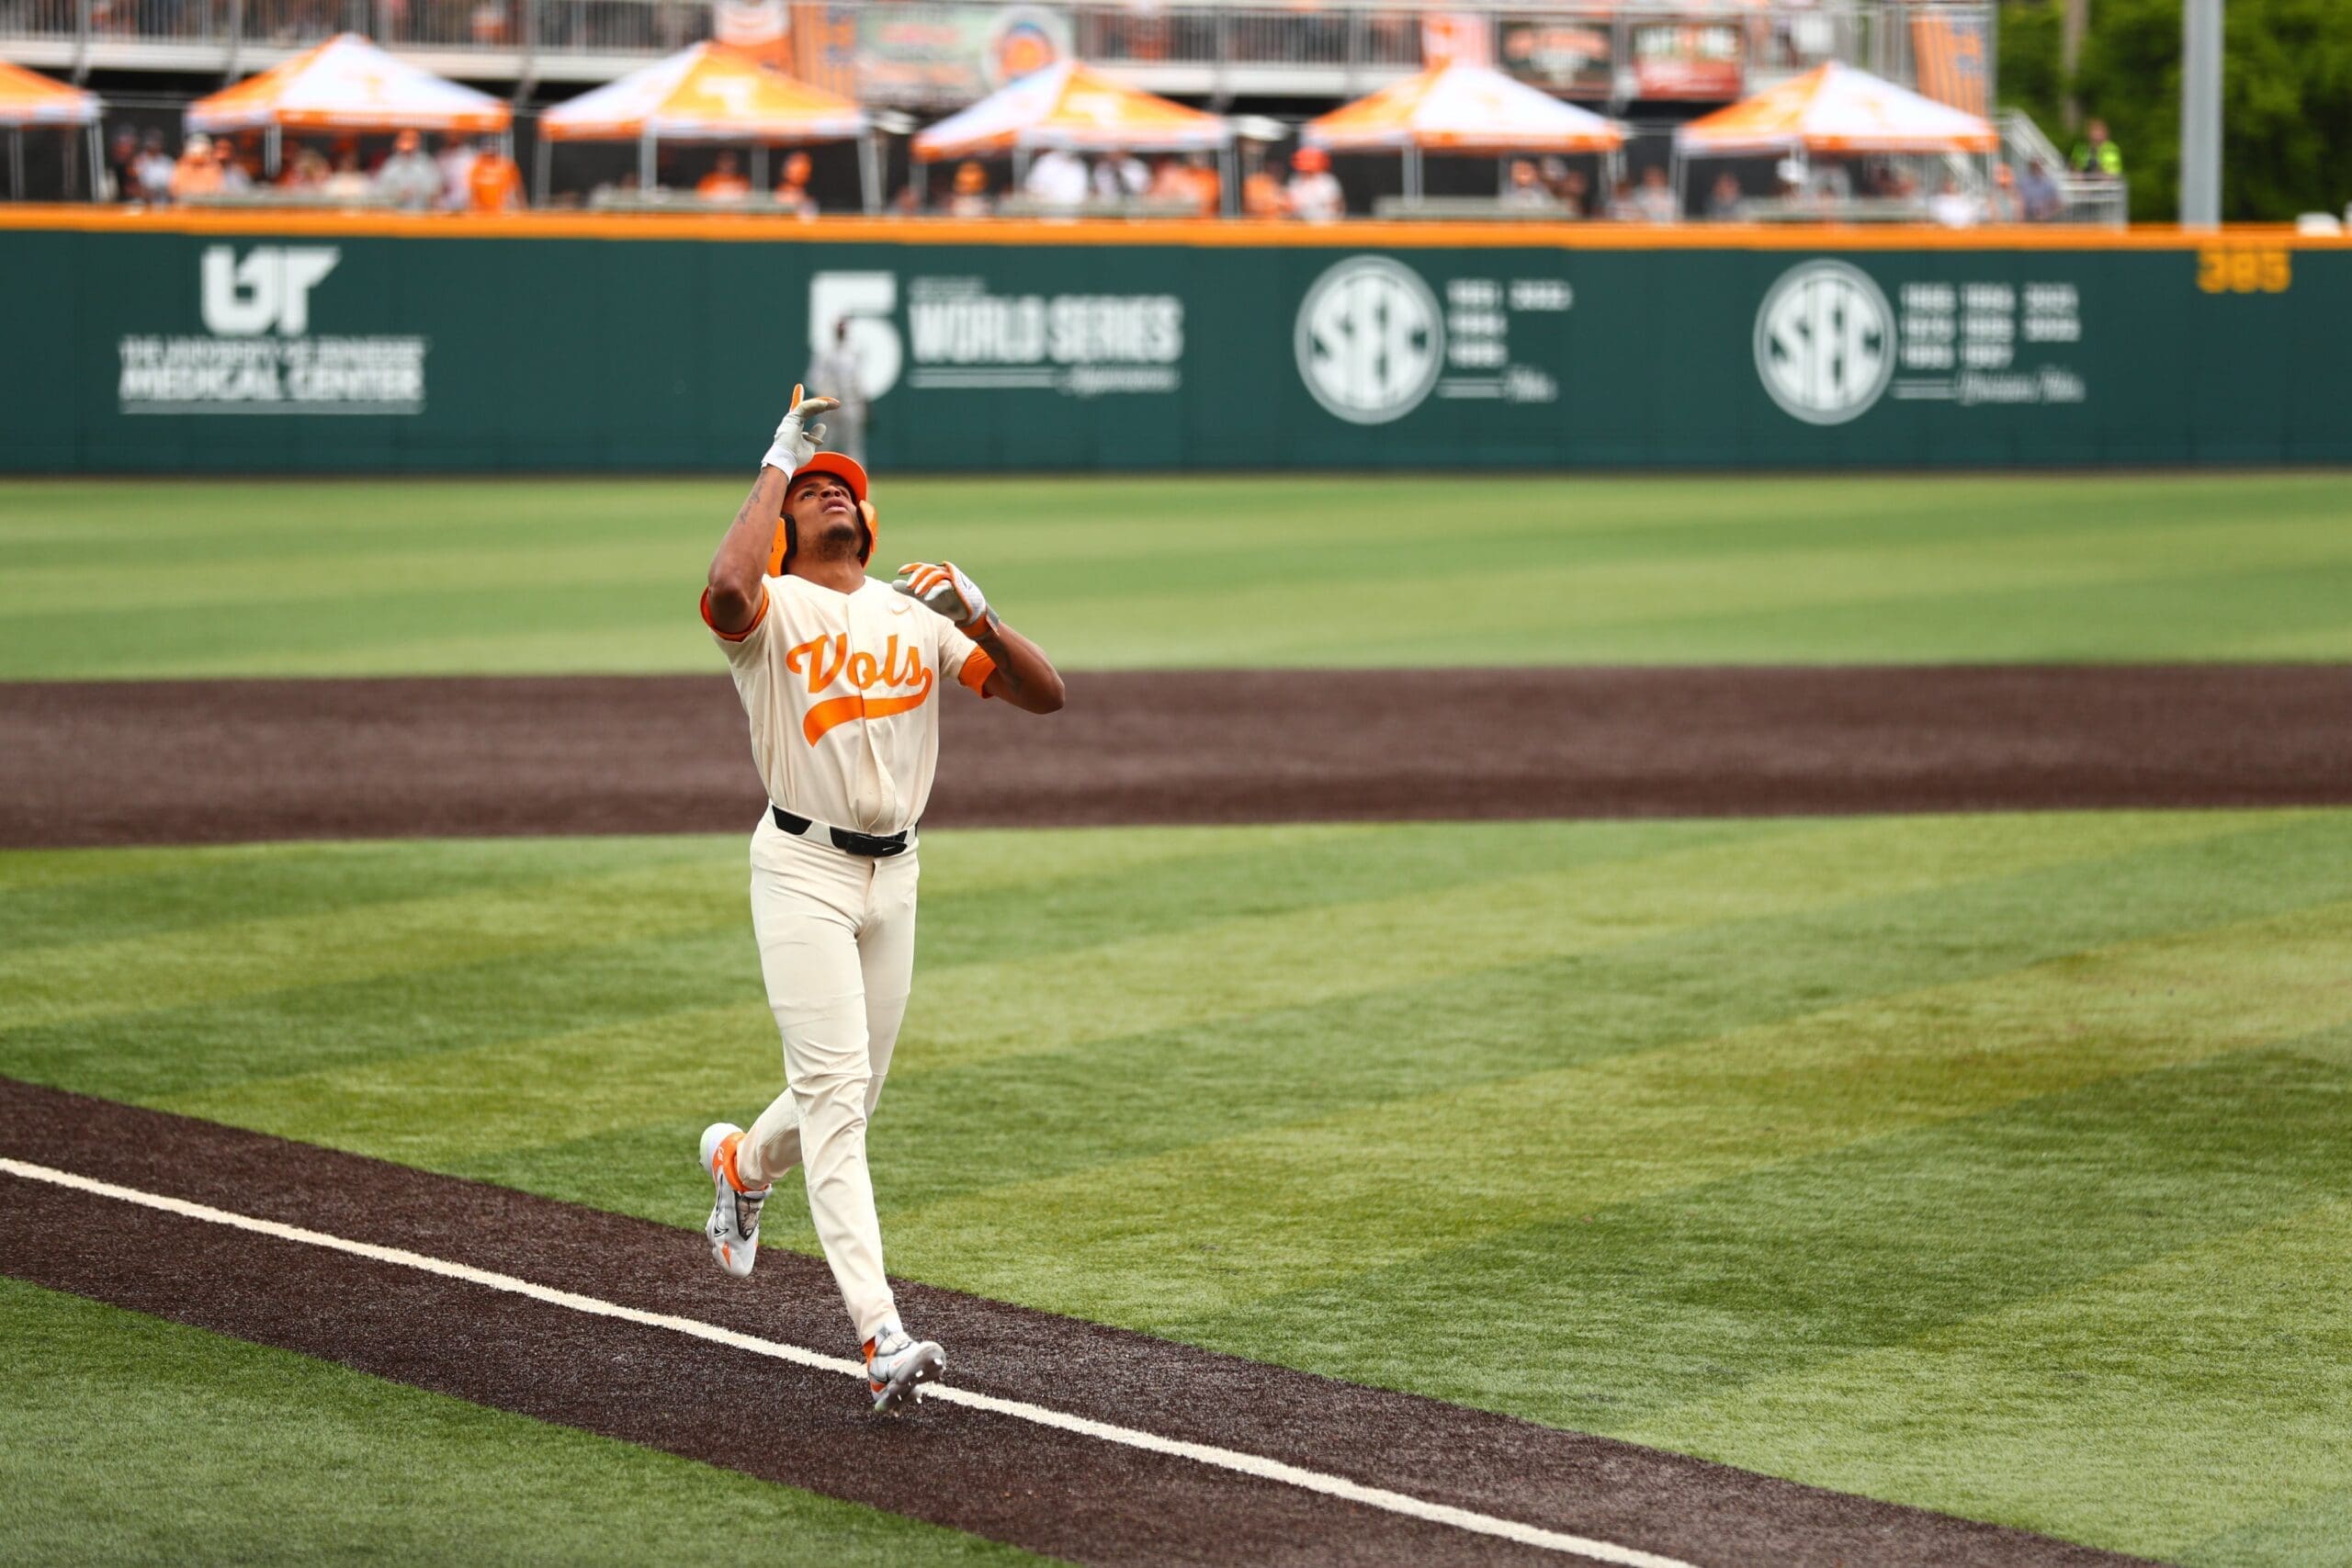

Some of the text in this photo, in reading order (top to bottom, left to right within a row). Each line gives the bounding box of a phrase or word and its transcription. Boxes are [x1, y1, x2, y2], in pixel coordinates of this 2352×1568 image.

[808, 271, 903, 402] 5
[908, 294, 1184, 364] WORLD SERIES
[1308, 272, 1430, 410] SEC
[1764, 274, 1884, 411] SEC
[119, 366, 426, 400] MEDICAL CENTER
[786, 631, 933, 695] Vols
